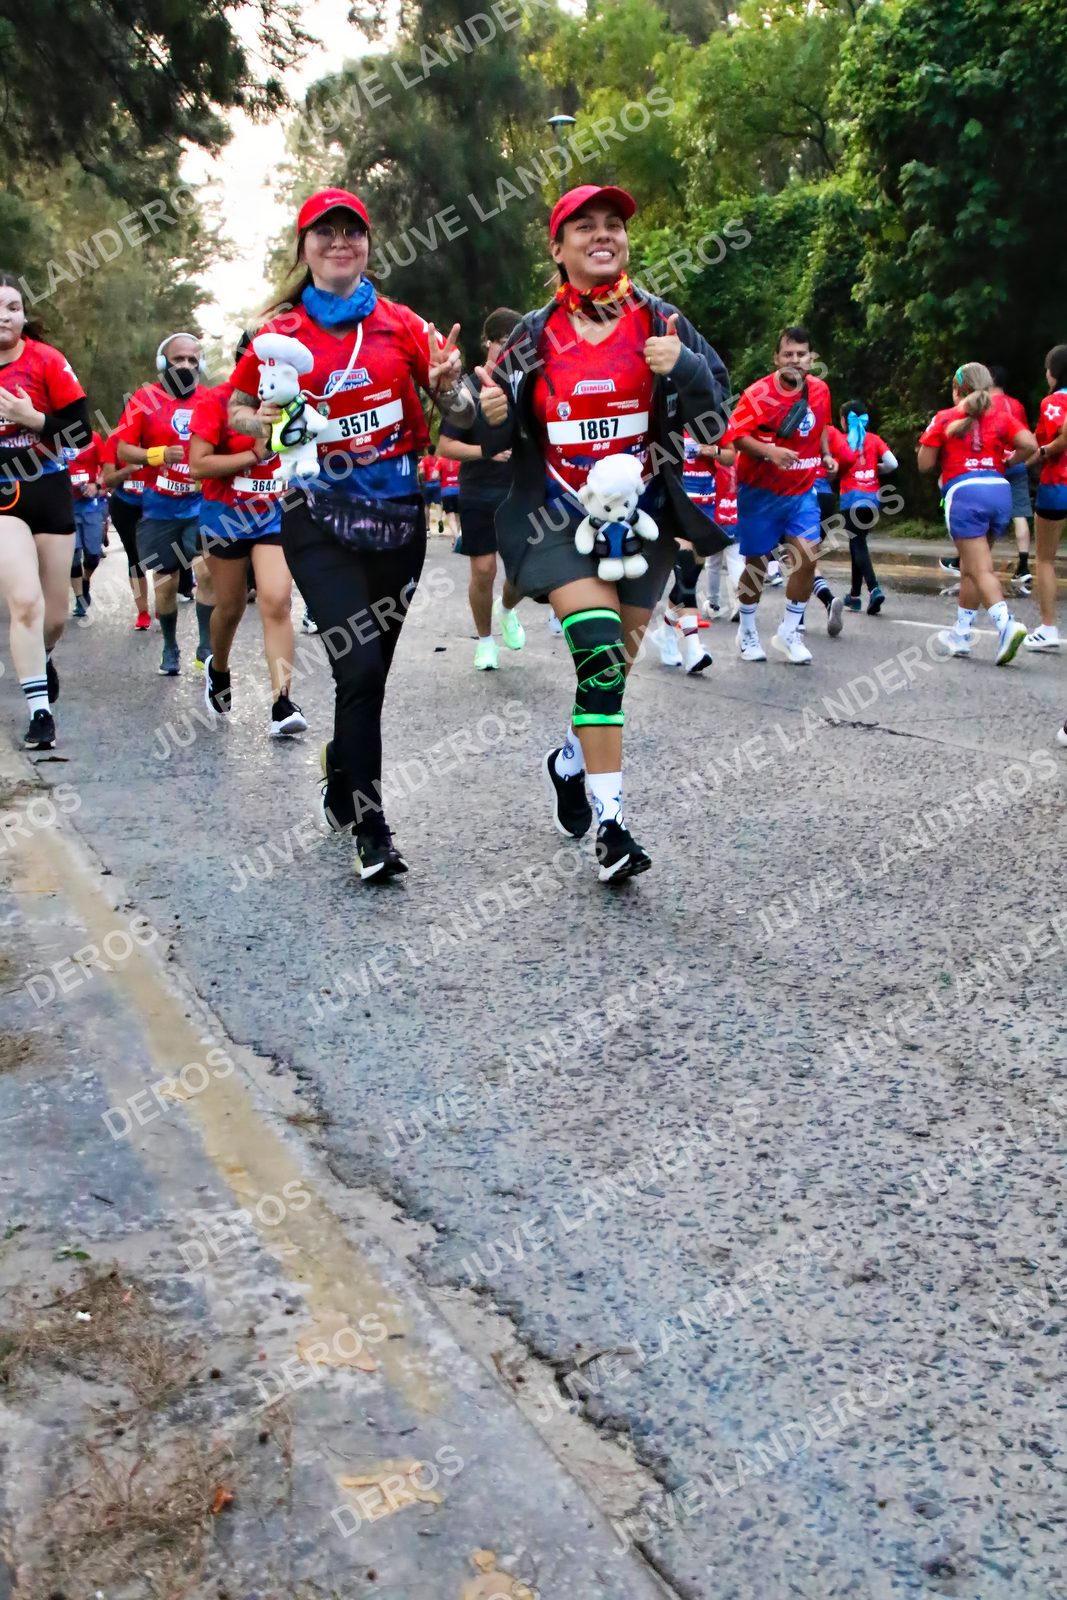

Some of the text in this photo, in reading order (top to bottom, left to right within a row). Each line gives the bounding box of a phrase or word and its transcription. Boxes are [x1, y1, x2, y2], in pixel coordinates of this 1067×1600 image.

[339, 410, 379, 437] 3574
[579, 418, 619, 440] 1867
[252, 480, 276, 492] 3644
